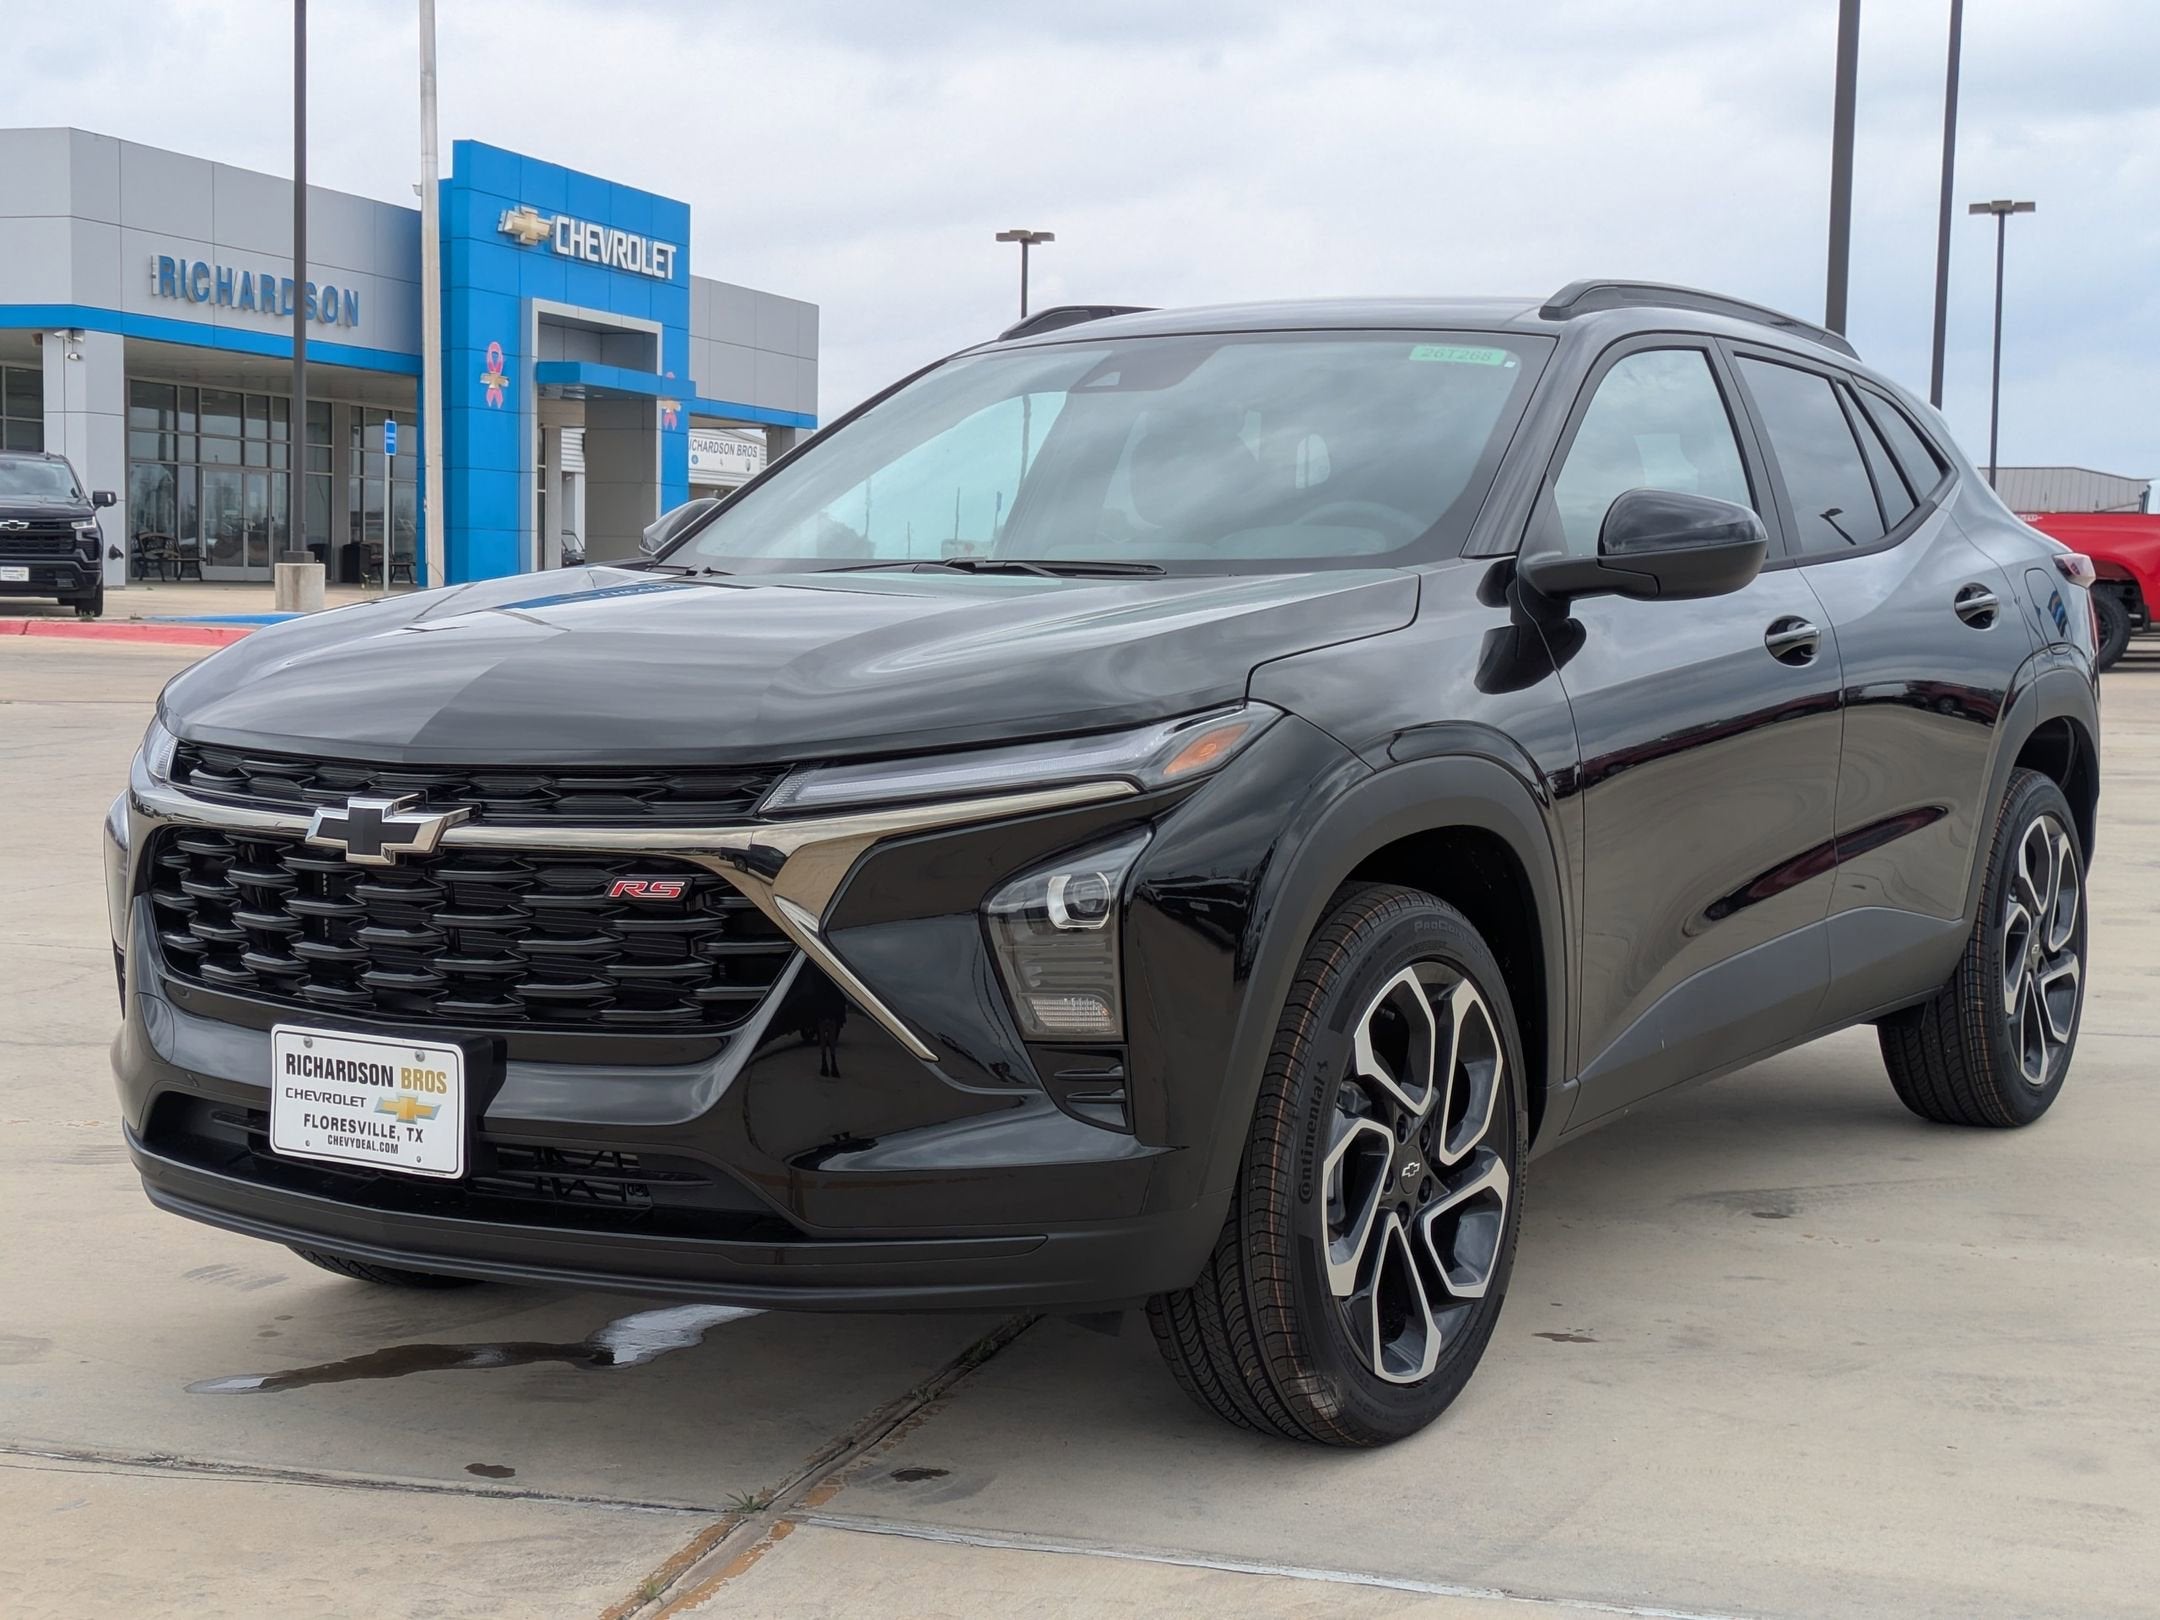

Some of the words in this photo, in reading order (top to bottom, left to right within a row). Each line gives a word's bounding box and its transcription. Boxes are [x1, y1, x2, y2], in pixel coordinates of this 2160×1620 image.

[555, 215, 677, 280] CHEVROLET
[152, 255, 359, 327] RICHARDSON
[736, 444, 758, 458] BROS
[609, 881, 685, 898] RS
[285, 1053, 394, 1088] RICHARDSON
[400, 1067, 448, 1094] BROS
[285, 1087, 367, 1108] CHEVROLET
[303, 1113, 400, 1142] FLORESVILLE,
[406, 1127, 424, 1143] TX
[1298, 1076, 1325, 1205] Continental
[327, 1135, 399, 1155] CHEVYDEAL.COM
